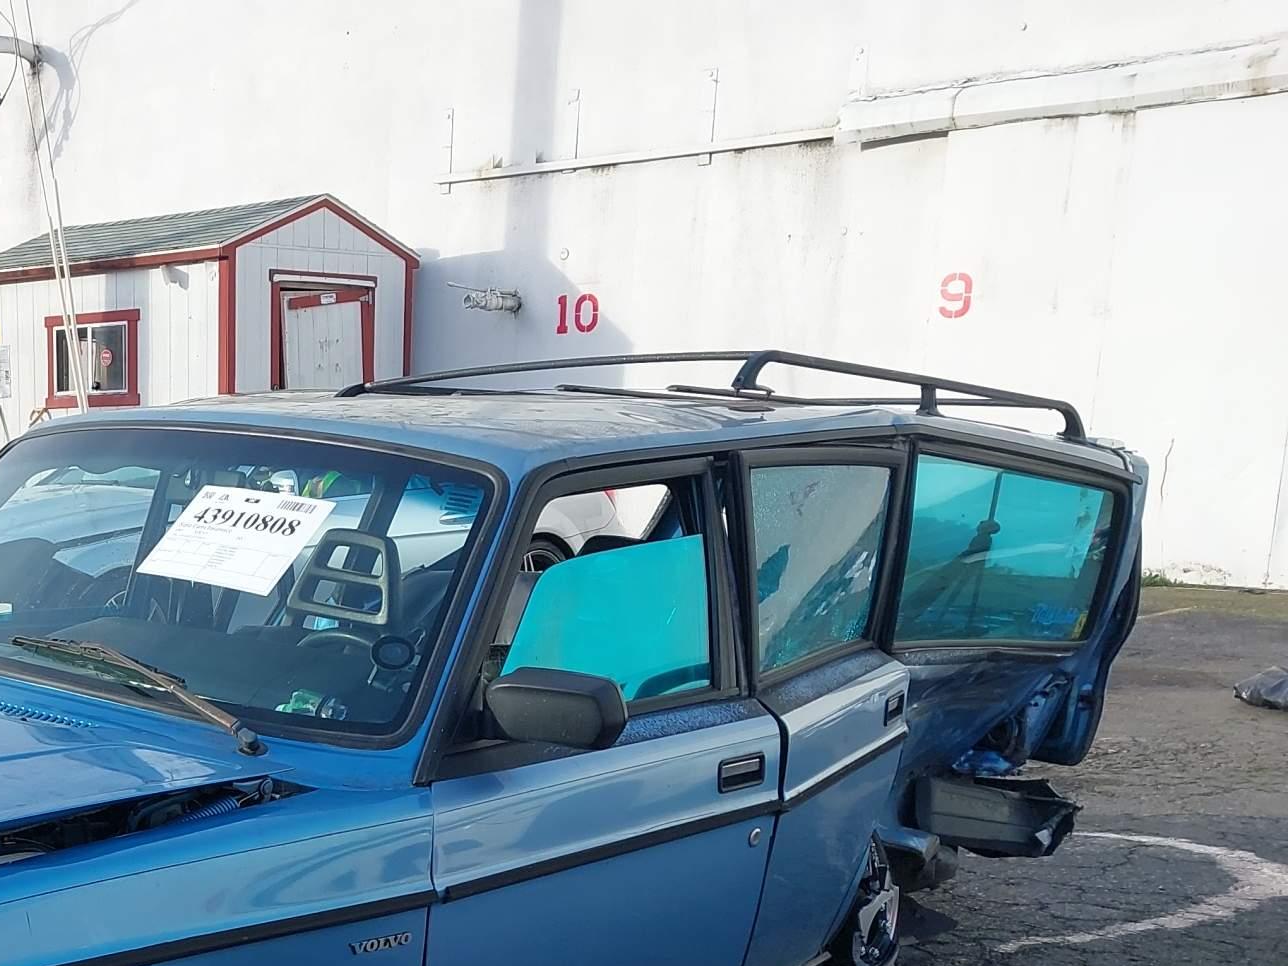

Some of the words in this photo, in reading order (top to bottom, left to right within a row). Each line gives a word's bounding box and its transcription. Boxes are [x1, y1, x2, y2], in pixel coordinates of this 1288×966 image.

[938, 272, 973, 318] 9
[556, 293, 599, 335] 10
[193, 506, 302, 537] 43910808
[350, 932, 412, 955] VOLVO
